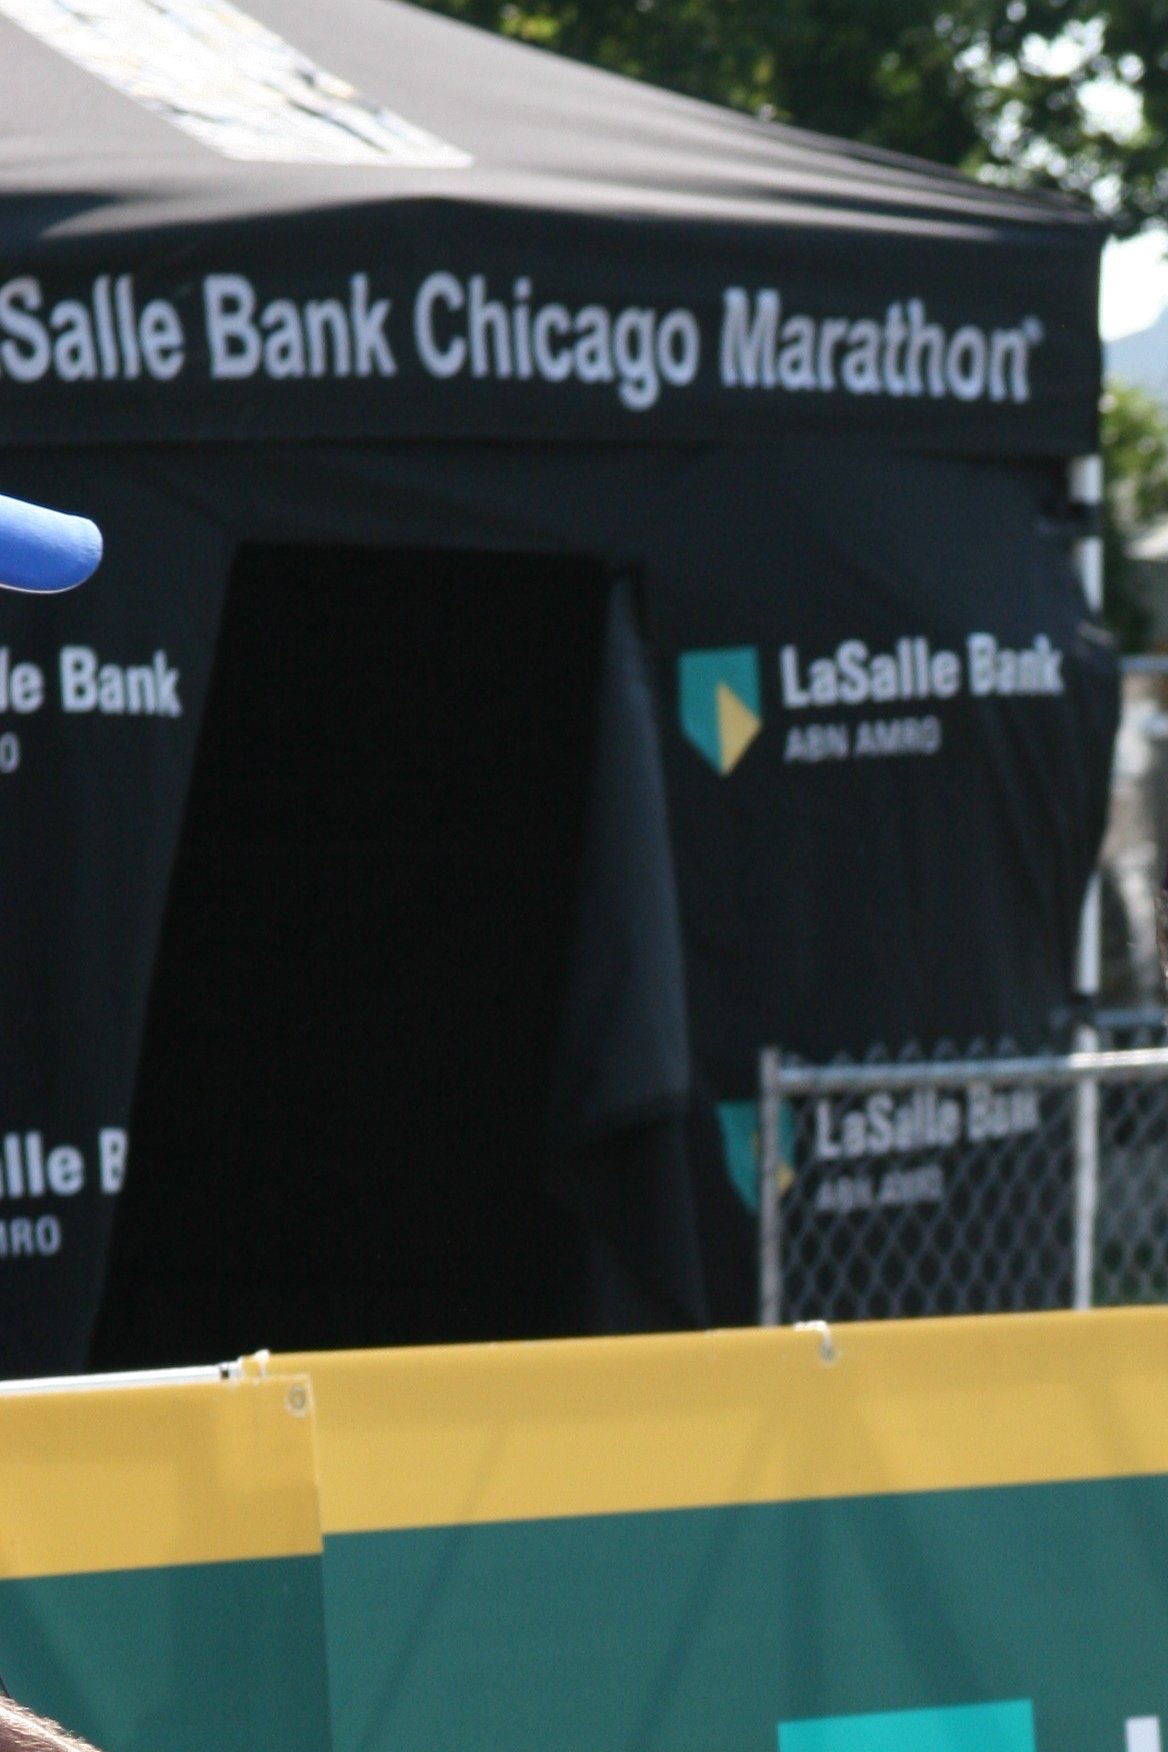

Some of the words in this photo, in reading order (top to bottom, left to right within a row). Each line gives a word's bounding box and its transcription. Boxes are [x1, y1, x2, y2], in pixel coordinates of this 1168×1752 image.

[0, 275, 186, 382] Salle
[203, 272, 397, 380] Bank
[413, 271, 700, 411] Chicago
[60, 644, 183, 719] Bank
[780, 638, 962, 709] LaSalle
[967, 631, 1064, 696] Bank
